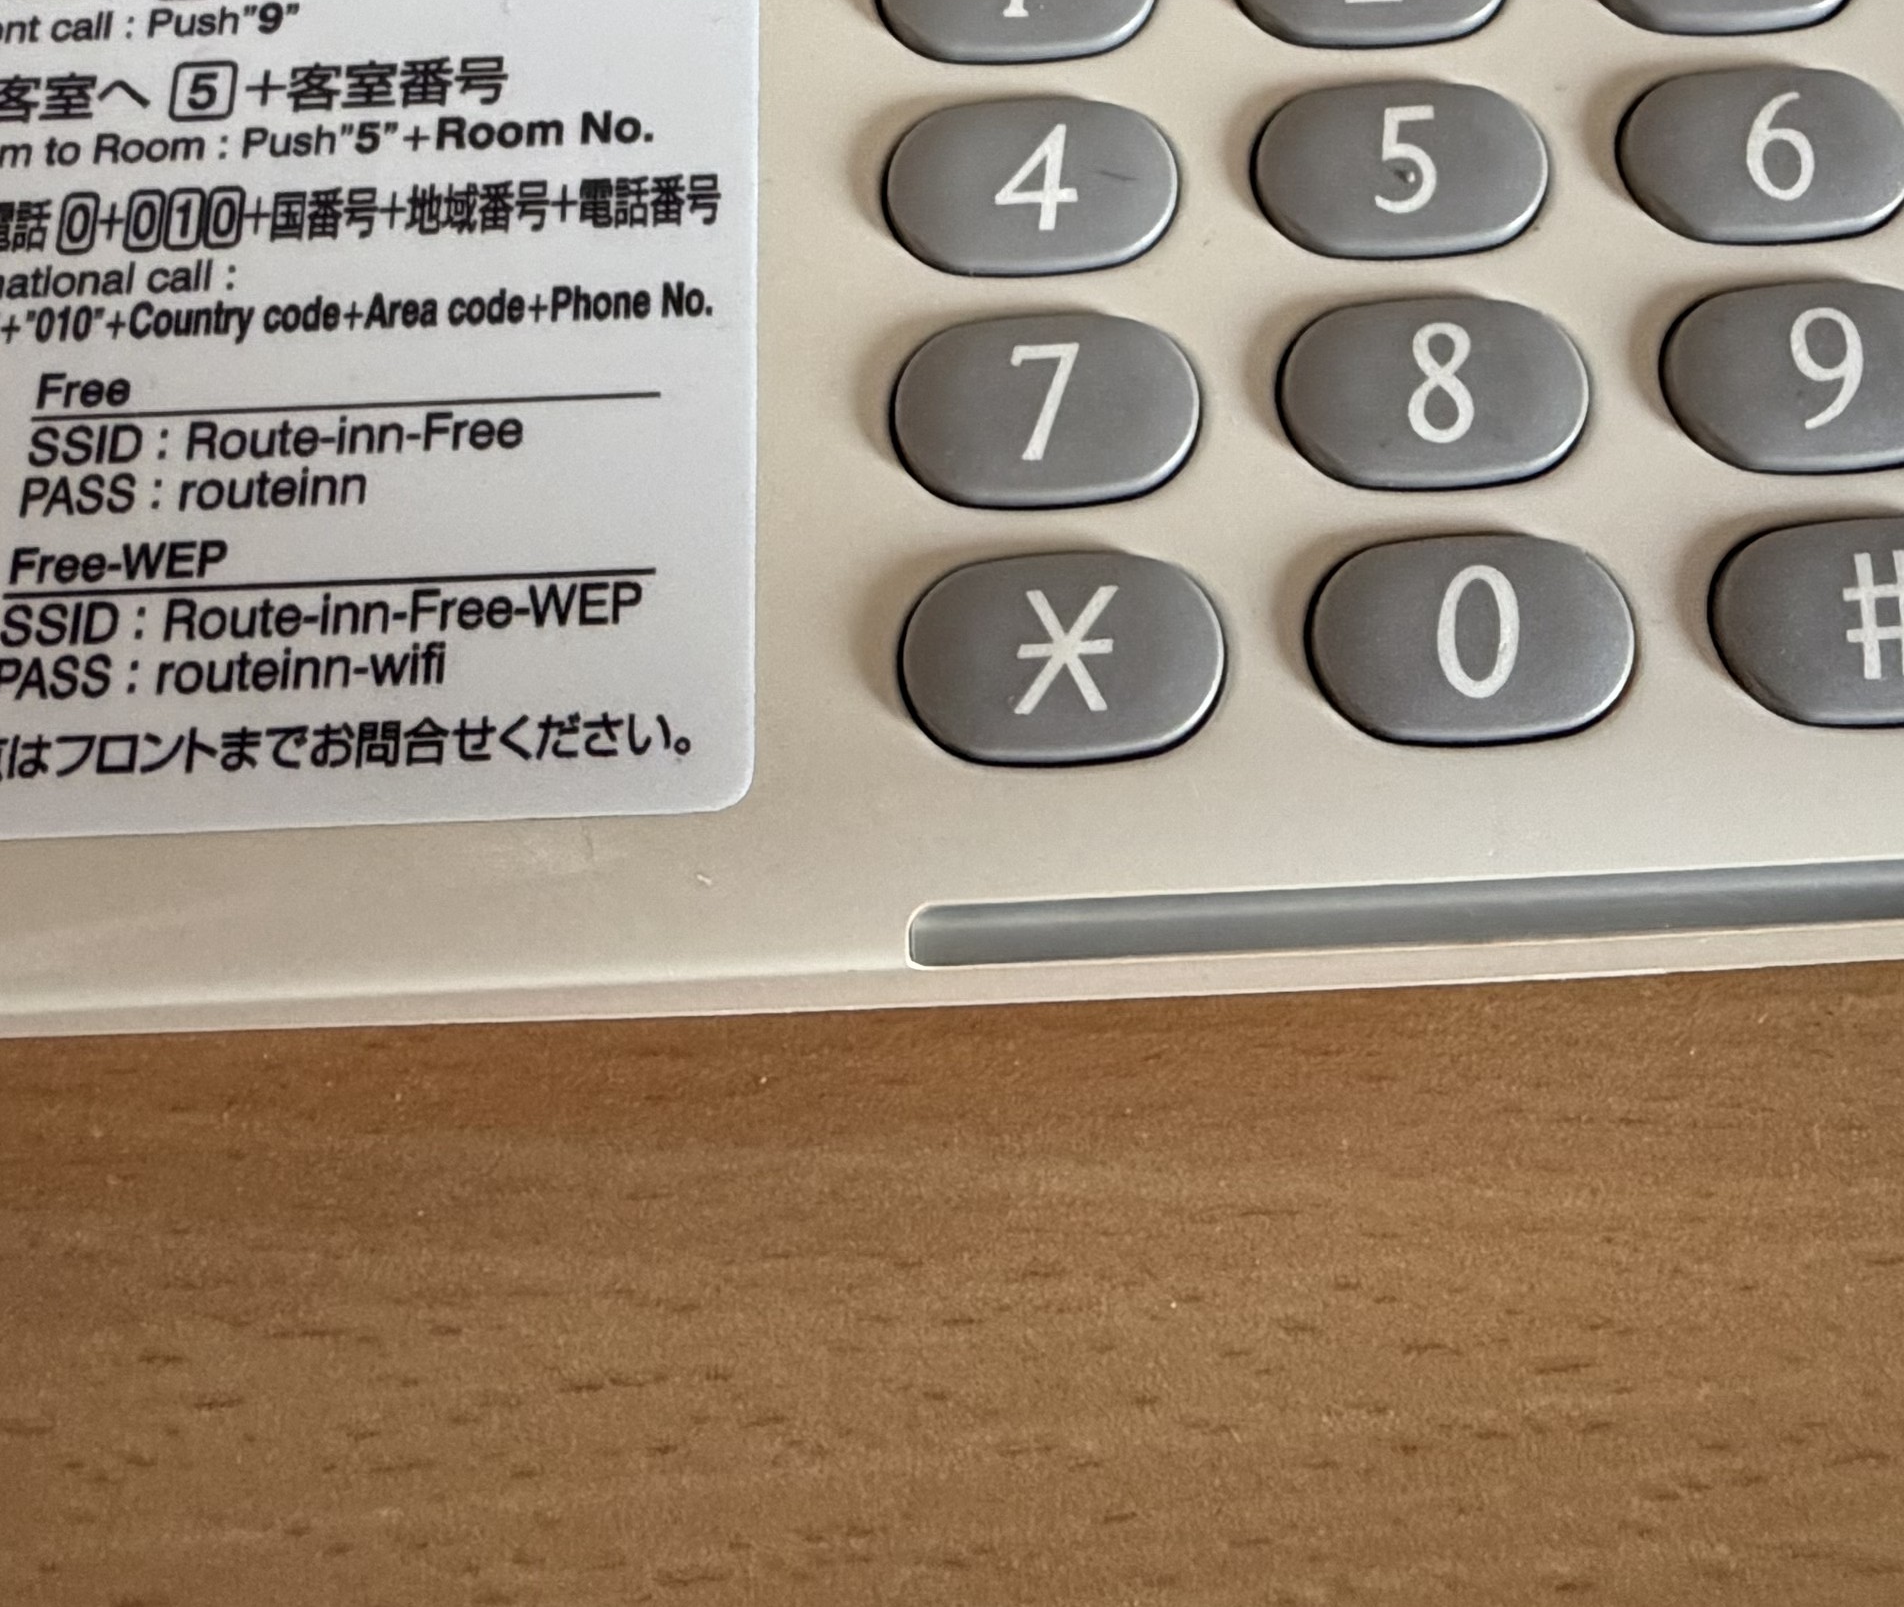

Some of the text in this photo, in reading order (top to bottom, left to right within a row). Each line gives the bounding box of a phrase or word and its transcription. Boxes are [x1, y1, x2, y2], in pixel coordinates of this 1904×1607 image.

[45, 137, 81, 166] to
[93, 132, 206, 164] Room
[580, 110, 654, 145] No.
[994, 91, 1816, 231] 4 5 6
[263, 292, 439, 333] code+Area
[447, 285, 652, 325] code+Phone
[661, 280, 714, 319] No.
[35, 372, 132, 409] Free
[1009, 306, 1864, 461] 7 8 9
[28, 423, 144, 467] SSID
[185, 411, 525, 462] Route-inn-Free
[19, 472, 137, 517] PASS
[178, 466, 368, 512] routeinn
[8, 539, 229, 585] Free-WEP
[0, 601, 120, 647] SSID
[163, 583, 643, 642] Route-inn-Free-WEP
[1436, 562, 1519, 698] 0
[156, 641, 446, 695] routeinn-wifi
